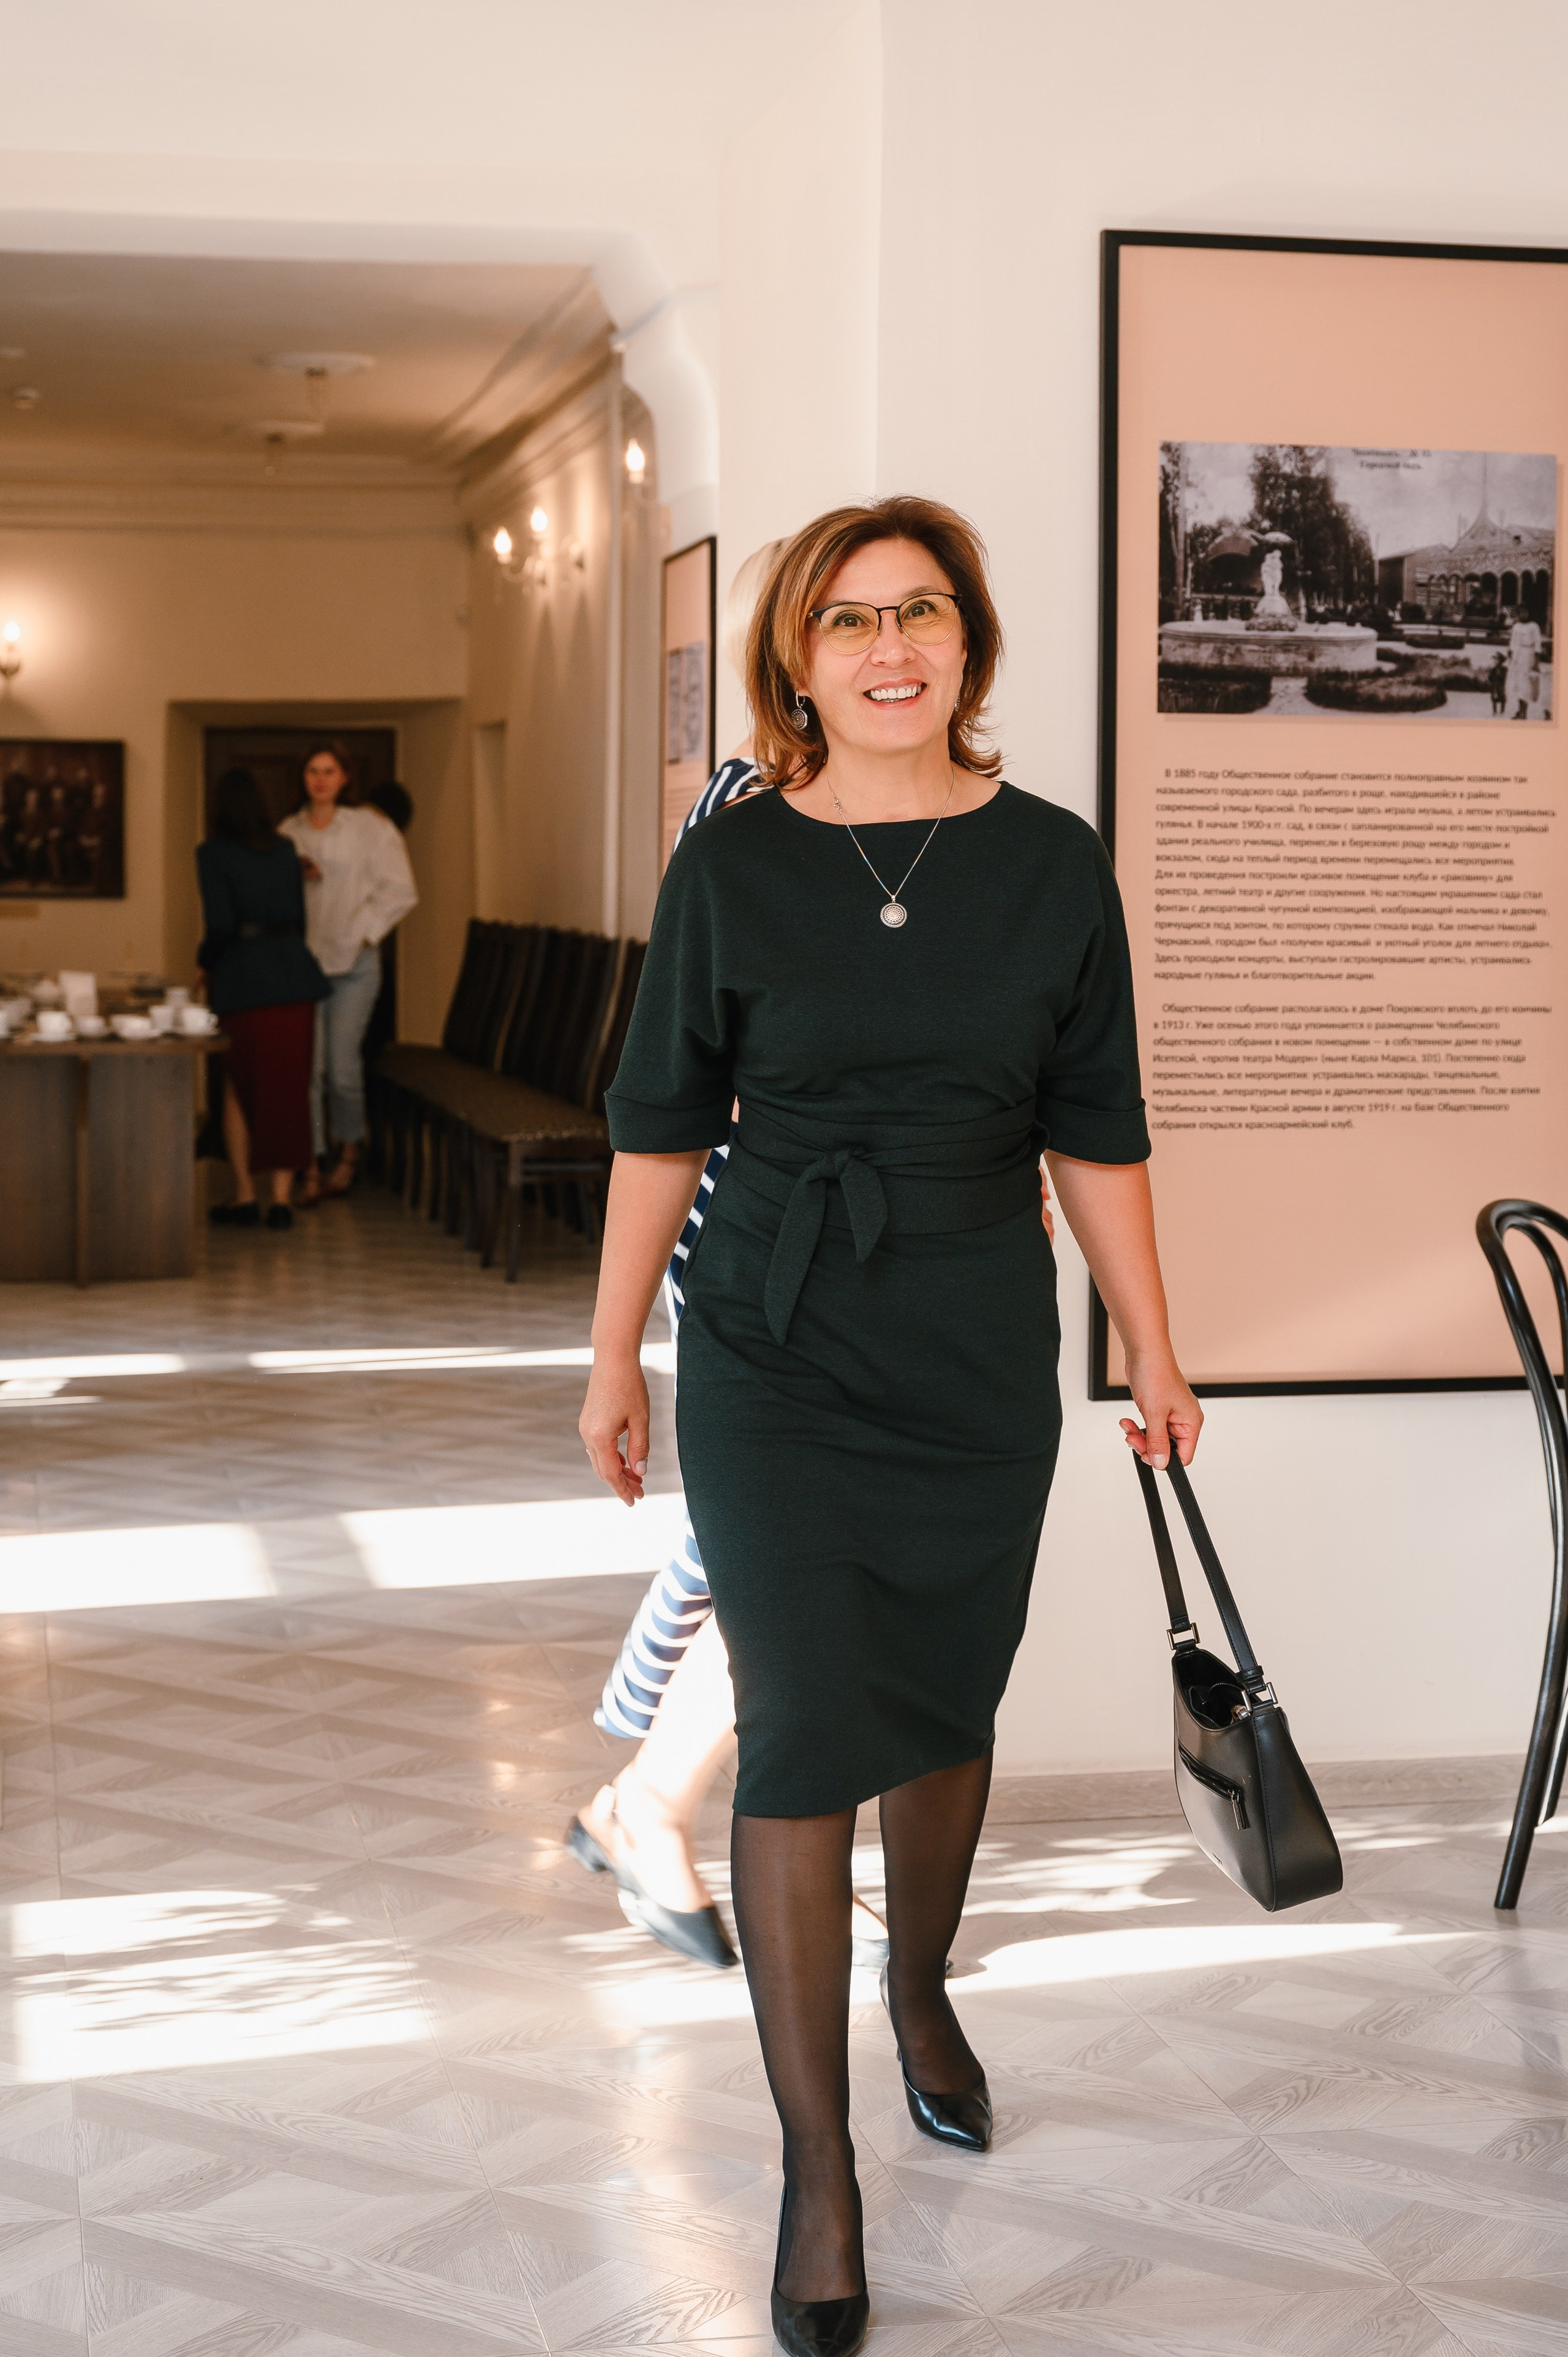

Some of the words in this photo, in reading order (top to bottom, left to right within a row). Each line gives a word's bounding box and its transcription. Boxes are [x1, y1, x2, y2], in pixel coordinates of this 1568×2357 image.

[1174, 769, 1197, 778] 1885
[1197, 771, 1221, 780] году
[1221, 769, 1292, 780] Общественное
[1294, 771, 1339, 781] собрание
[1393, 774, 1465, 783] полноправным
[1221, 788, 1275, 797] городского
[1302, 787, 1351, 798] разбитого
[1389, 790, 1458, 799] находившейся
[1466, 791, 1501, 800] районе
[1155, 803, 1221, 812] современной
[1222, 805, 1253, 813] улицы
[1298, 804, 1313, 813] По
[1356, 807, 1383, 815] здесь
[1495, 809, 1557, 817] устраивались
[1351, 823, 1434, 832] запланированной
[1494, 825, 1550, 834] постройкой
[1289, 839, 1340, 848] перенесли
[1401, 840, 1427, 849] рощу
[1428, 841, 1460, 850] между
[1283, 856, 1319, 864] период
[1363, 857, 1433, 865] перемещались
[1154, 869, 1174, 880] Для
[1189, 872, 1246, 880] проведения
[1248, 872, 1298, 881] построили
[1402, 872, 1430, 881] клуба
[1202, 887, 1237, 896] летний
[1238, 889, 1264, 897] театр
[1273, 889, 1306, 898] другие
[1385, 890, 1438, 899] настоящим
[1499, 891, 1522, 900] сада
[1154, 903, 1189, 913] фонтан
[1197, 904, 1266, 914] декоративной
[1267, 904, 1311, 914] чугунной
[1381, 905, 1454, 915] изображающей
[1154, 921, 1212, 930] прячущихся
[1213, 922, 1232, 930] под
[1286, 922, 1332, 931] которому
[1496, 923, 1537, 932] Николай
[1257, 937, 1278, 946] был
[1325, 938, 1371, 948] красивый
[1384, 938, 1421, 948] уютный
[1155, 953, 1182, 964] Здесь
[1183, 955, 1236, 964] проходили
[1250, 970, 1344, 981] благотворительные
[1161, 1003, 1233, 1013] Общественное
[1234, 1003, 1280, 1014] собрание
[1385, 1004, 1446, 1014] Покровского
[1161, 1020, 1185, 1030] 1913
[1436, 1020, 1501, 1030] Челябинского
[1153, 1036, 1226, 1047] общественного
[1227, 1037, 1273, 1047] собрания
[1392, 1037, 1453, 1046] собственном
[1242, 1055, 1273, 1064] театра
[1350, 1055, 1379, 1063] Карла
[1445, 1053, 1501, 1062] Постепенно
[1501, 1055, 1526, 1063] сюда
[1152, 1072, 1226, 1080] переместились
[1312, 1072, 1375, 1080] устраивались
[1221, 1088, 1289, 1097] литературные
[1332, 1088, 1404, 1097] драматические
[1480, 1085, 1509, 1095] После
[1152, 1104, 1208, 1113] Челябинска
[1250, 1103, 1290, 1114] Красной
[1368, 1103, 1390, 1112] 1919
[1413, 1102, 1436, 1112] базе
[1437, 1102, 1510, 1112] Общественного
[1151, 1120, 1197, 1130] собрания
[1244, 1120, 1329, 1130] красноармейский
